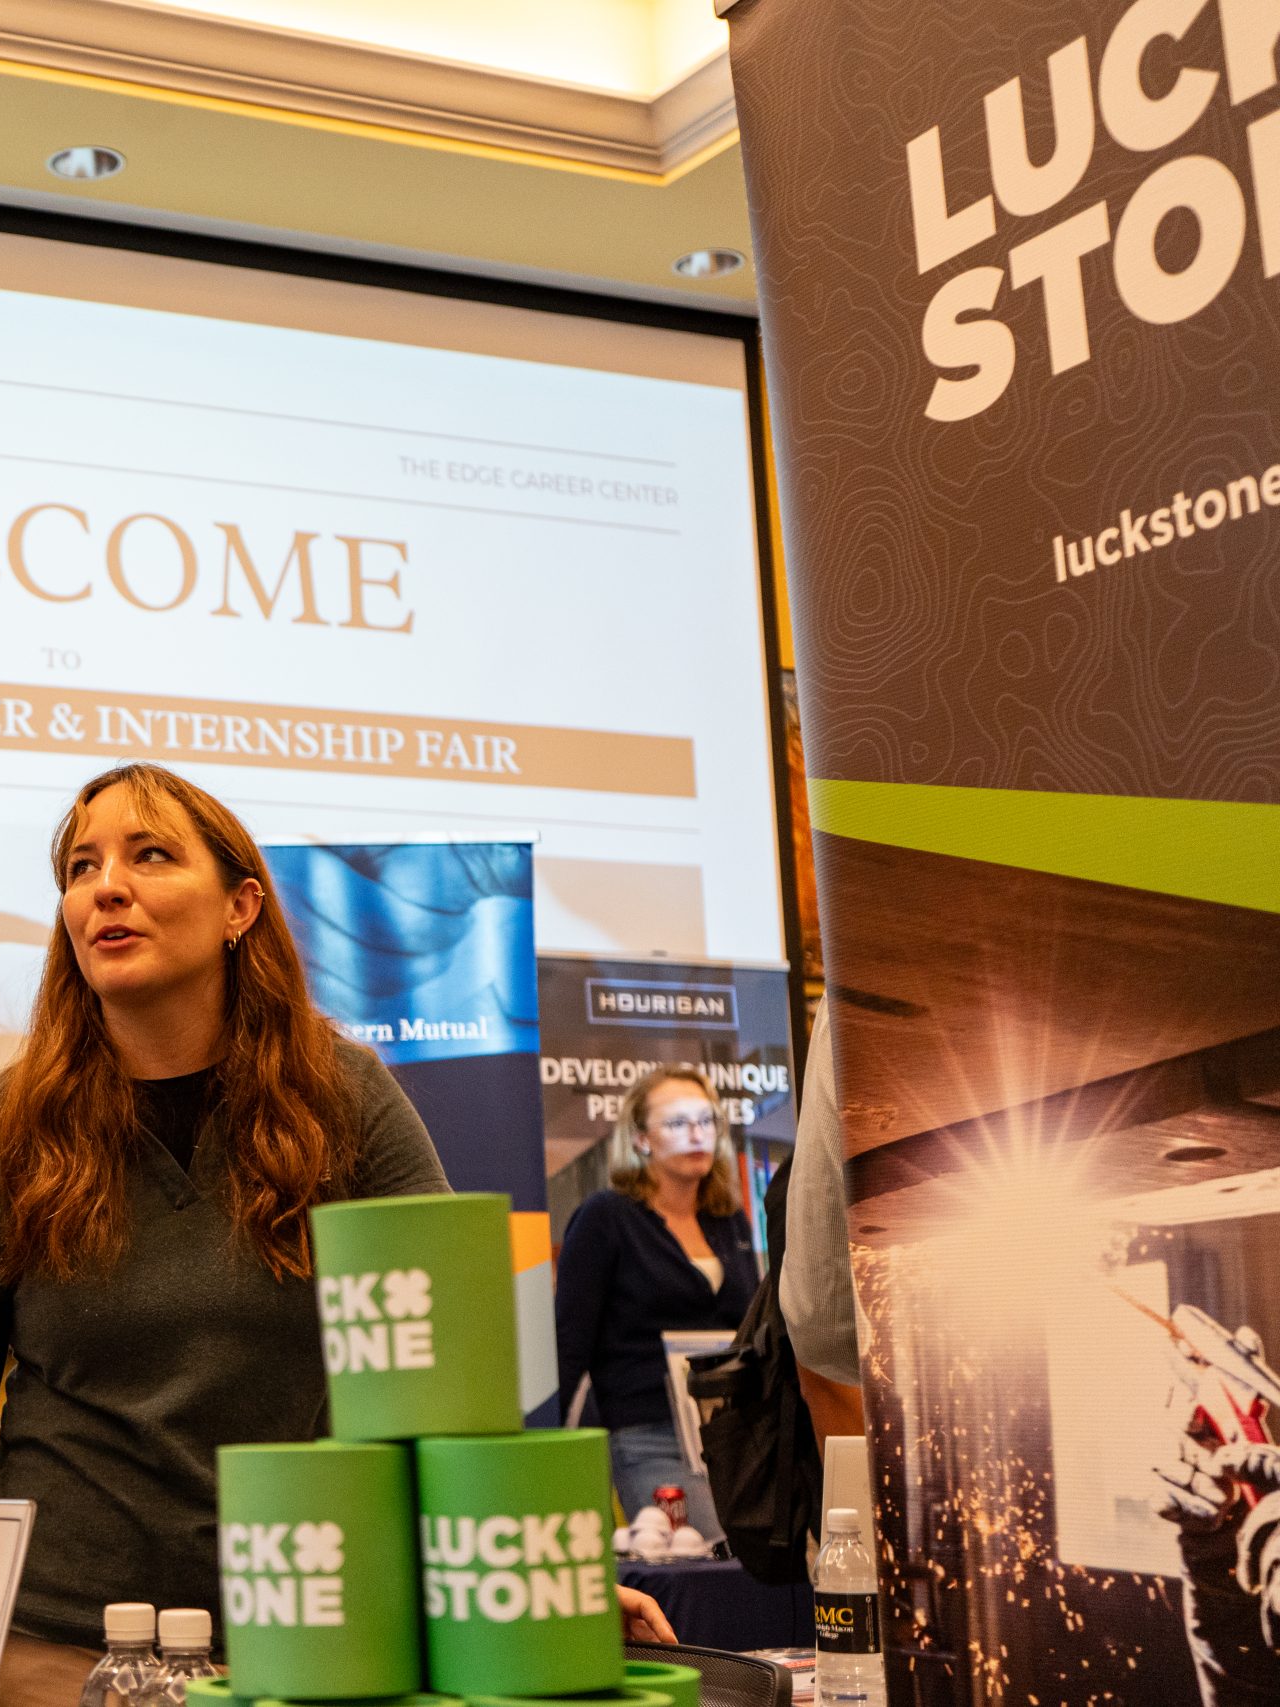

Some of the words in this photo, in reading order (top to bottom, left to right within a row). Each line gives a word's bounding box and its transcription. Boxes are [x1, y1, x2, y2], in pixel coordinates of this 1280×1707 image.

[923, 107, 1280, 422] STO
[399, 456, 441, 480] THE
[447, 461, 505, 488] EDGE
[510, 469, 594, 497] CAREER
[598, 479, 679, 506] CENTER
[41, 647, 82, 671] TO
[48, 703, 86, 741] &
[96, 705, 405, 764] INTERNSHIP
[415, 730, 522, 774] FAIR
[399, 1016, 489, 1041] Mutual
[598, 992, 726, 1017] HOURIGAN
[422, 1514, 566, 1568] LUCK
[425, 1564, 609, 1622] STONE
